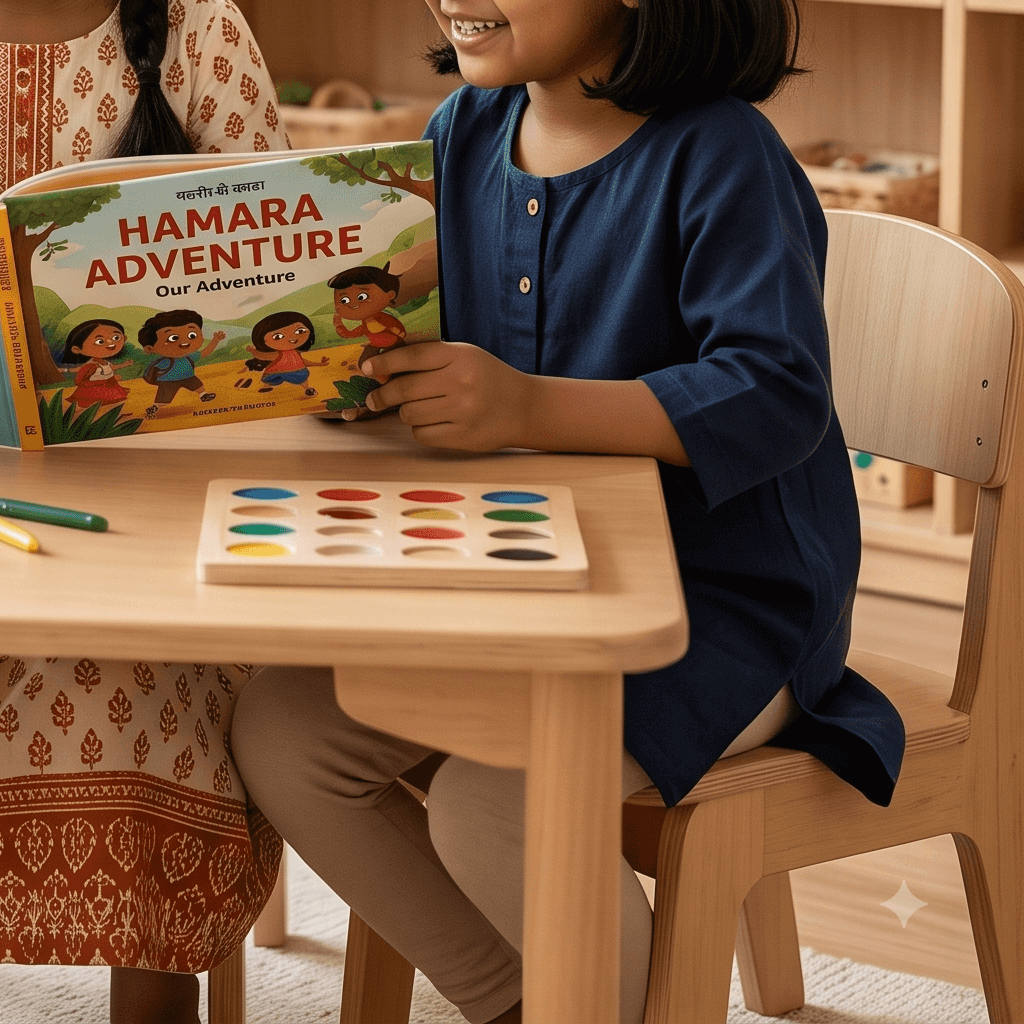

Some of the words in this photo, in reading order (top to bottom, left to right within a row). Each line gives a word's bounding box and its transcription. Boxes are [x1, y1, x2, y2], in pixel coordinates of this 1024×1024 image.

[118, 193, 323, 246] HAMARA
[85, 224, 363, 288] ADVENTURE
[155, 284, 191, 297] Our
[196, 272, 296, 293] Adventure
